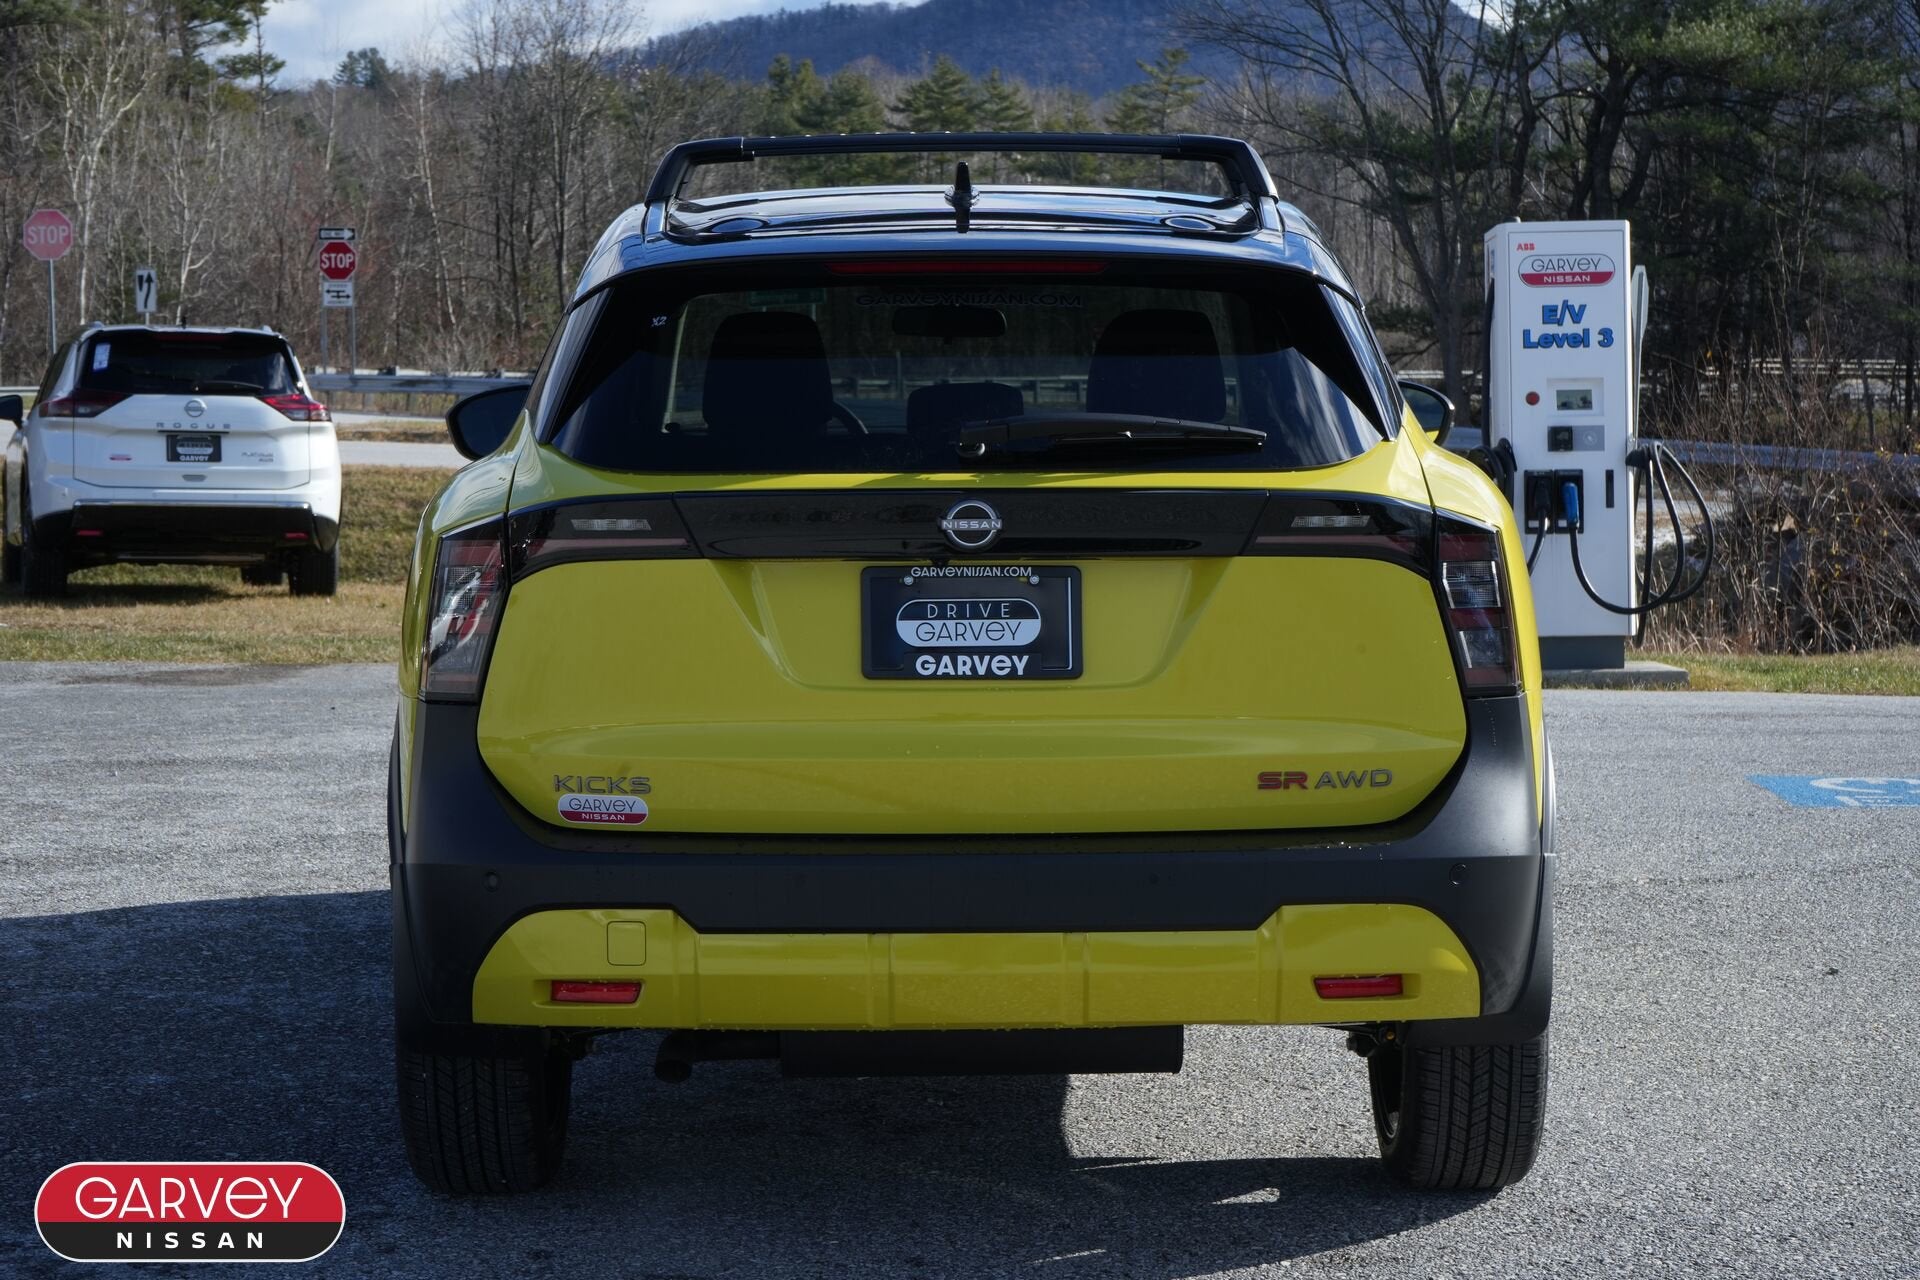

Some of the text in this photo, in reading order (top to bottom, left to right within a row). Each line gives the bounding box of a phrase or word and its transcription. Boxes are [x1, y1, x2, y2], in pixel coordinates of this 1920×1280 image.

[28, 225, 69, 244] STOP
[1516, 243, 1535, 251] ABB
[321, 253, 354, 269] STOP
[1543, 275, 1591, 283] NISSAN
[1542, 300, 1587, 326] E/V
[1523, 327, 1614, 349] Level 3
[156, 422, 231, 430] ROGUE
[943, 521, 1001, 529] NISSAN
[927, 603, 1011, 619] DRIVE
[553, 774, 652, 795] KICKS
[1257, 768, 1393, 790] SR AWD
[581, 813, 625, 821] NISSAN
